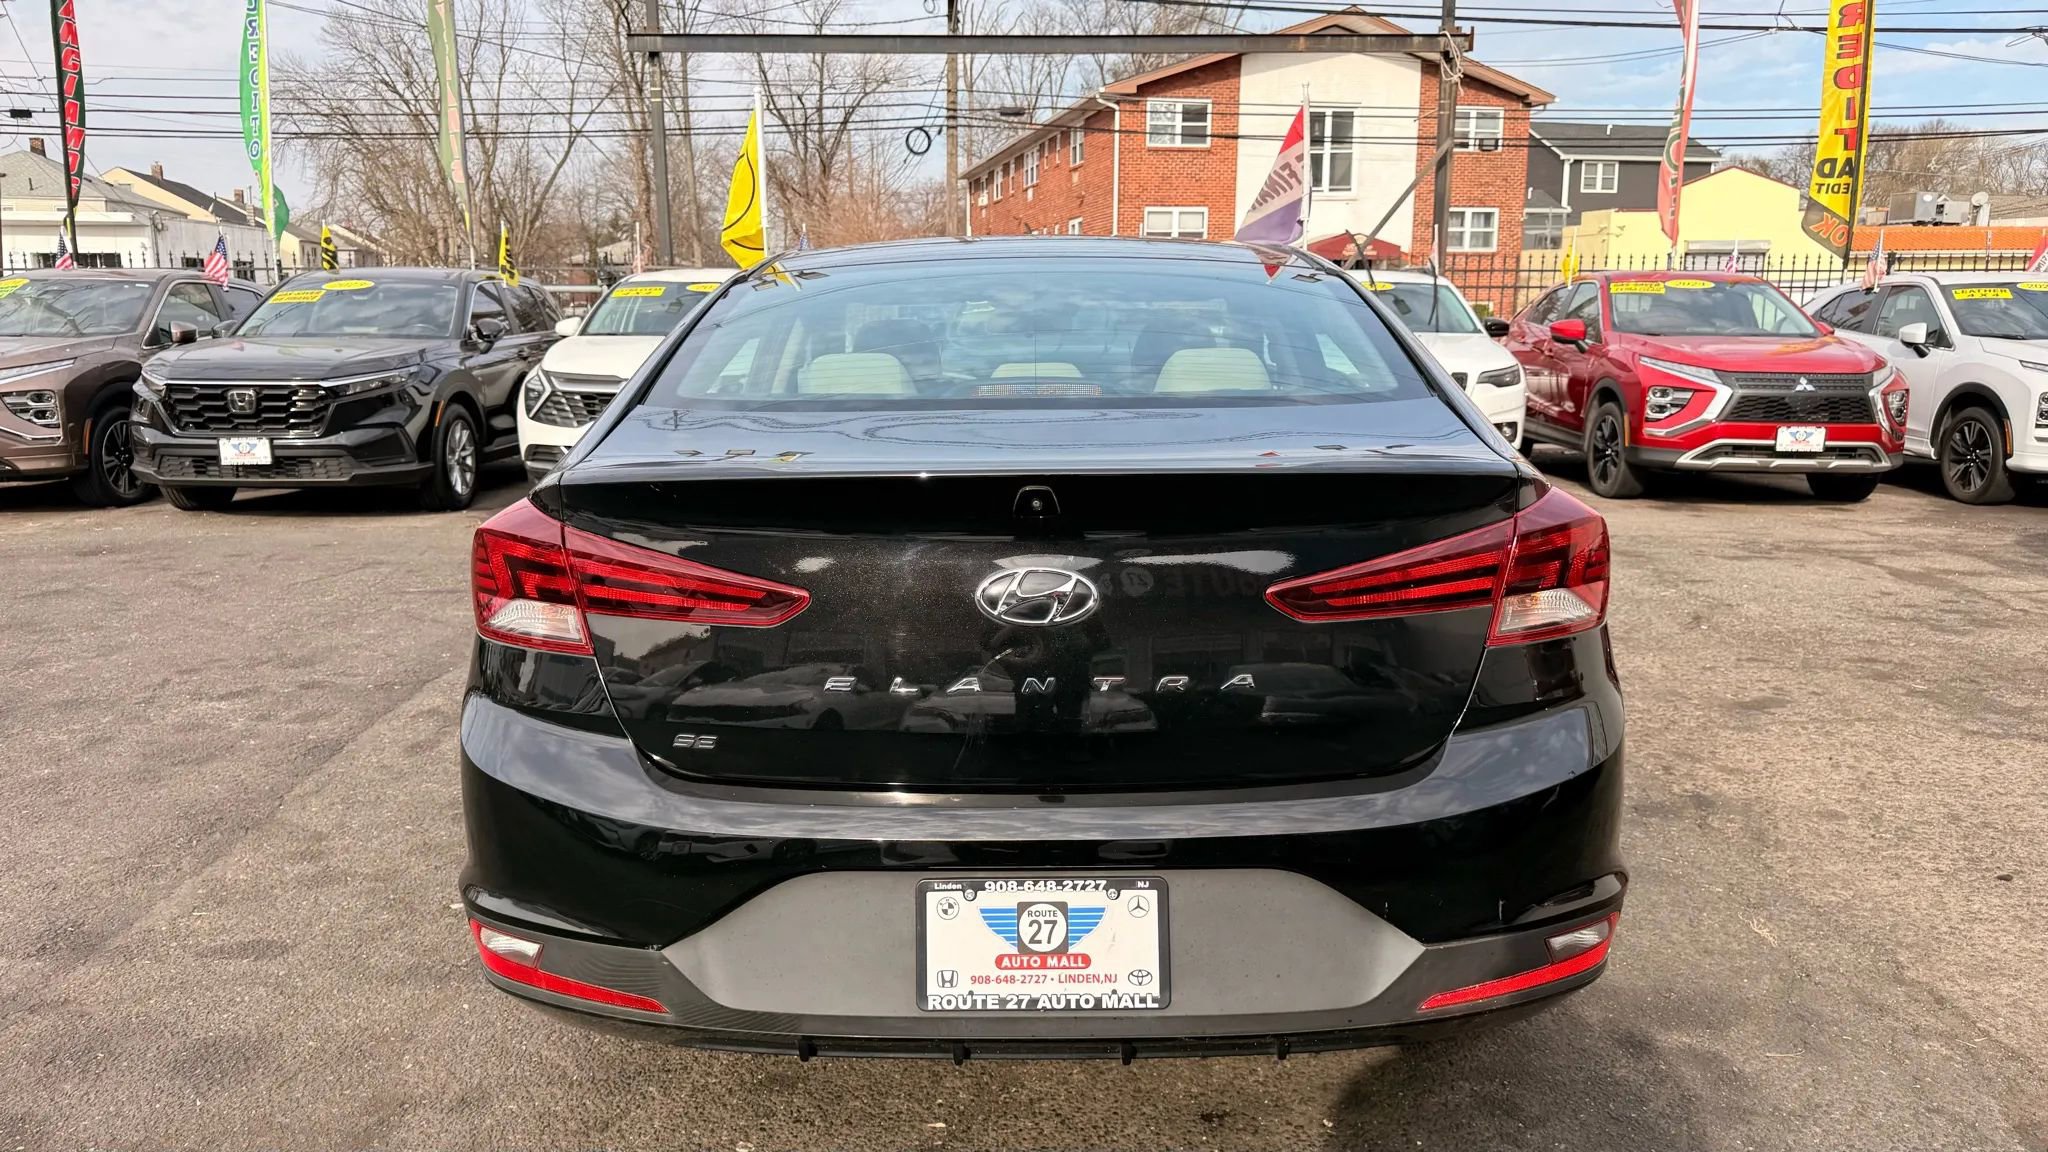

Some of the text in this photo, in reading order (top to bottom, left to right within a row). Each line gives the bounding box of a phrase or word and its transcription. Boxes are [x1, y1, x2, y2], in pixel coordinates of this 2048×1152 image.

[822, 676, 1257, 694] ELANTRA
[672, 733, 718, 750] SE
[934, 882, 962, 890] Linden
[984, 879, 1108, 893] 908-648-2727
[1136, 880, 1150, 889] NJ
[1026, 909, 1059, 919] ROUTE
[1027, 919, 1059, 945] 27
[1001, 955, 1087, 968] AUTO MALL
[970, 974, 1048, 985] 908-648-2727
[927, 993, 1160, 1011] ROUTE 27 AUTO MALL
